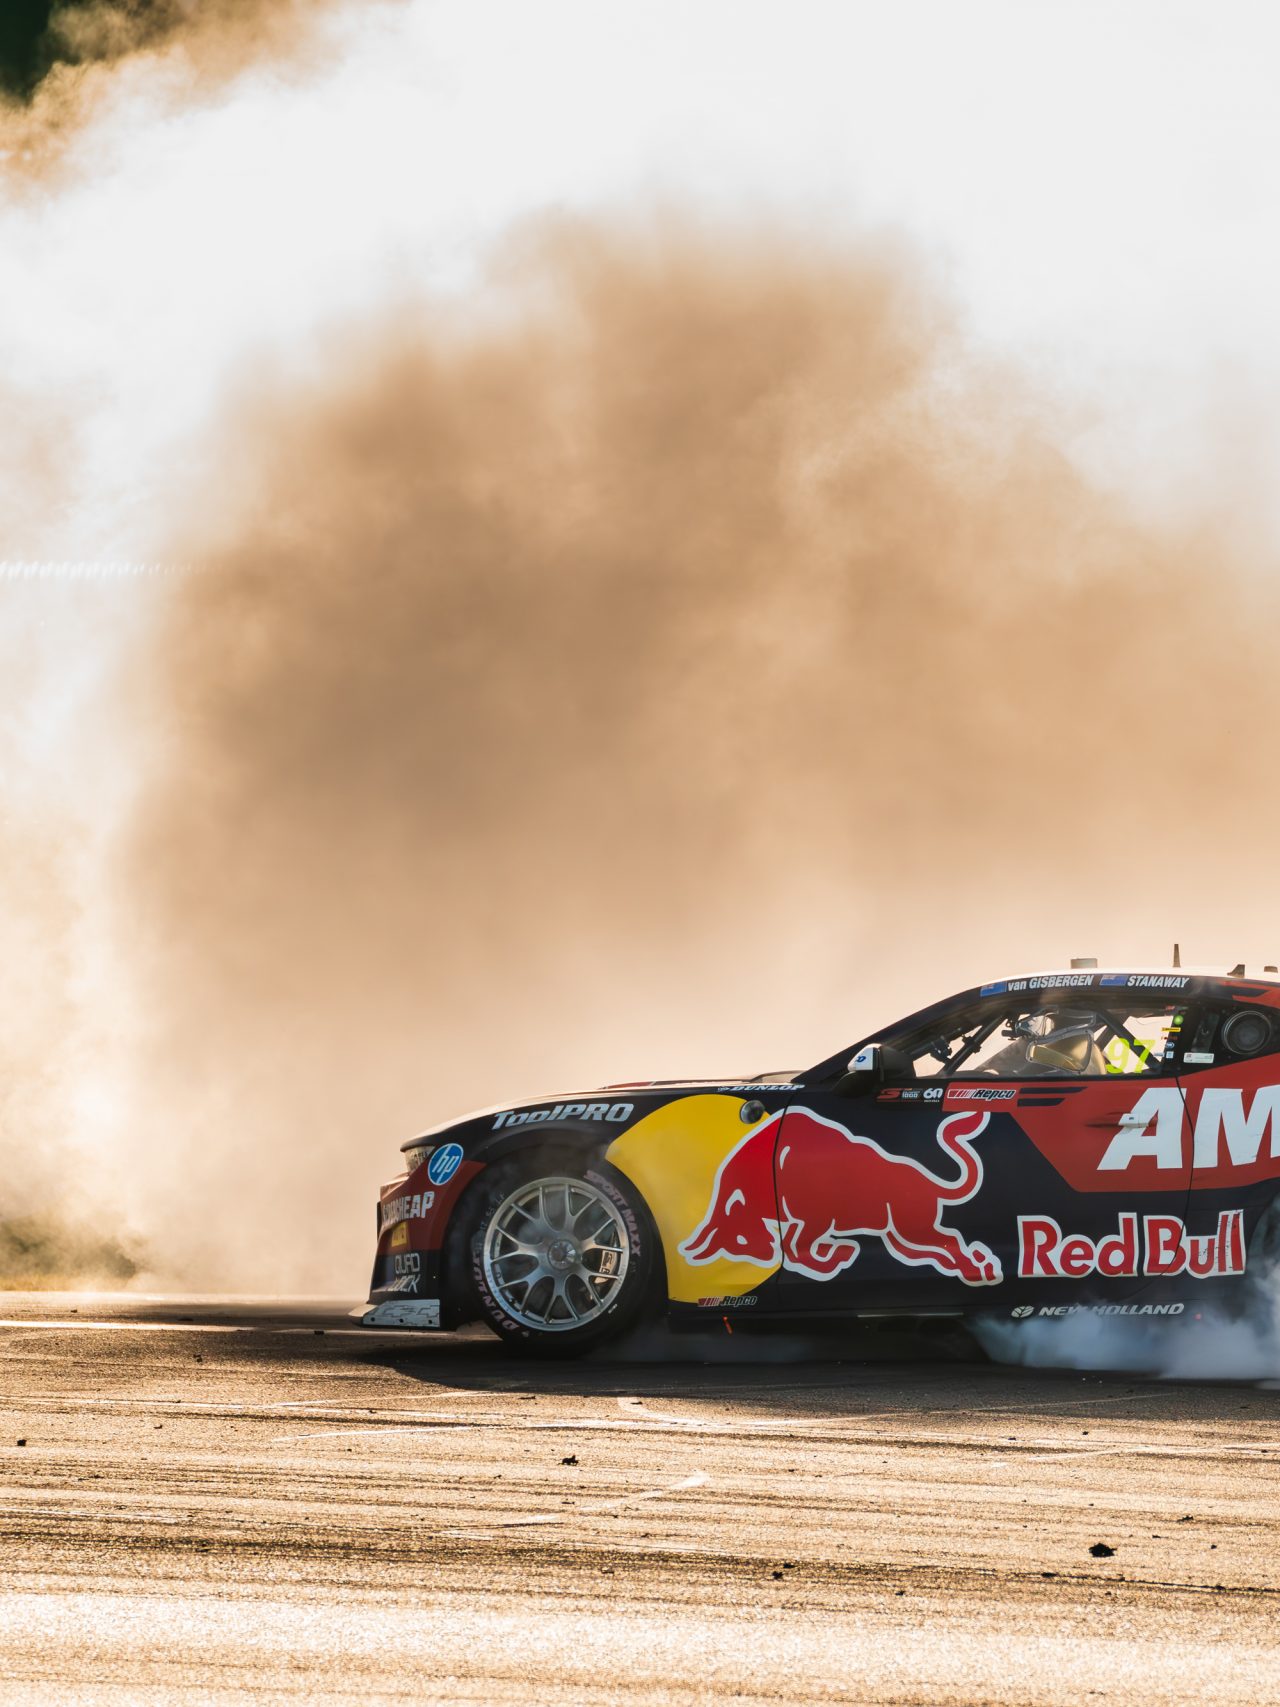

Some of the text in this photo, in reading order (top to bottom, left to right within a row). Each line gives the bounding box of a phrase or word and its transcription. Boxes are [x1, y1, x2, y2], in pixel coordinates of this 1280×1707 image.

[1008, 975, 1095, 991] van GISBERGEN
[1127, 976, 1189, 988] STANAWAY
[1105, 1037, 1157, 1074] 97
[970, 1088, 1017, 1101] Repco
[431, 1145, 460, 1184] hp
[1017, 1209, 1247, 1278] Red Bull
[395, 1252, 421, 1275] QUAD
[720, 1295, 759, 1308] Repco
[1091, 1303, 1185, 1316] HOLLAND
